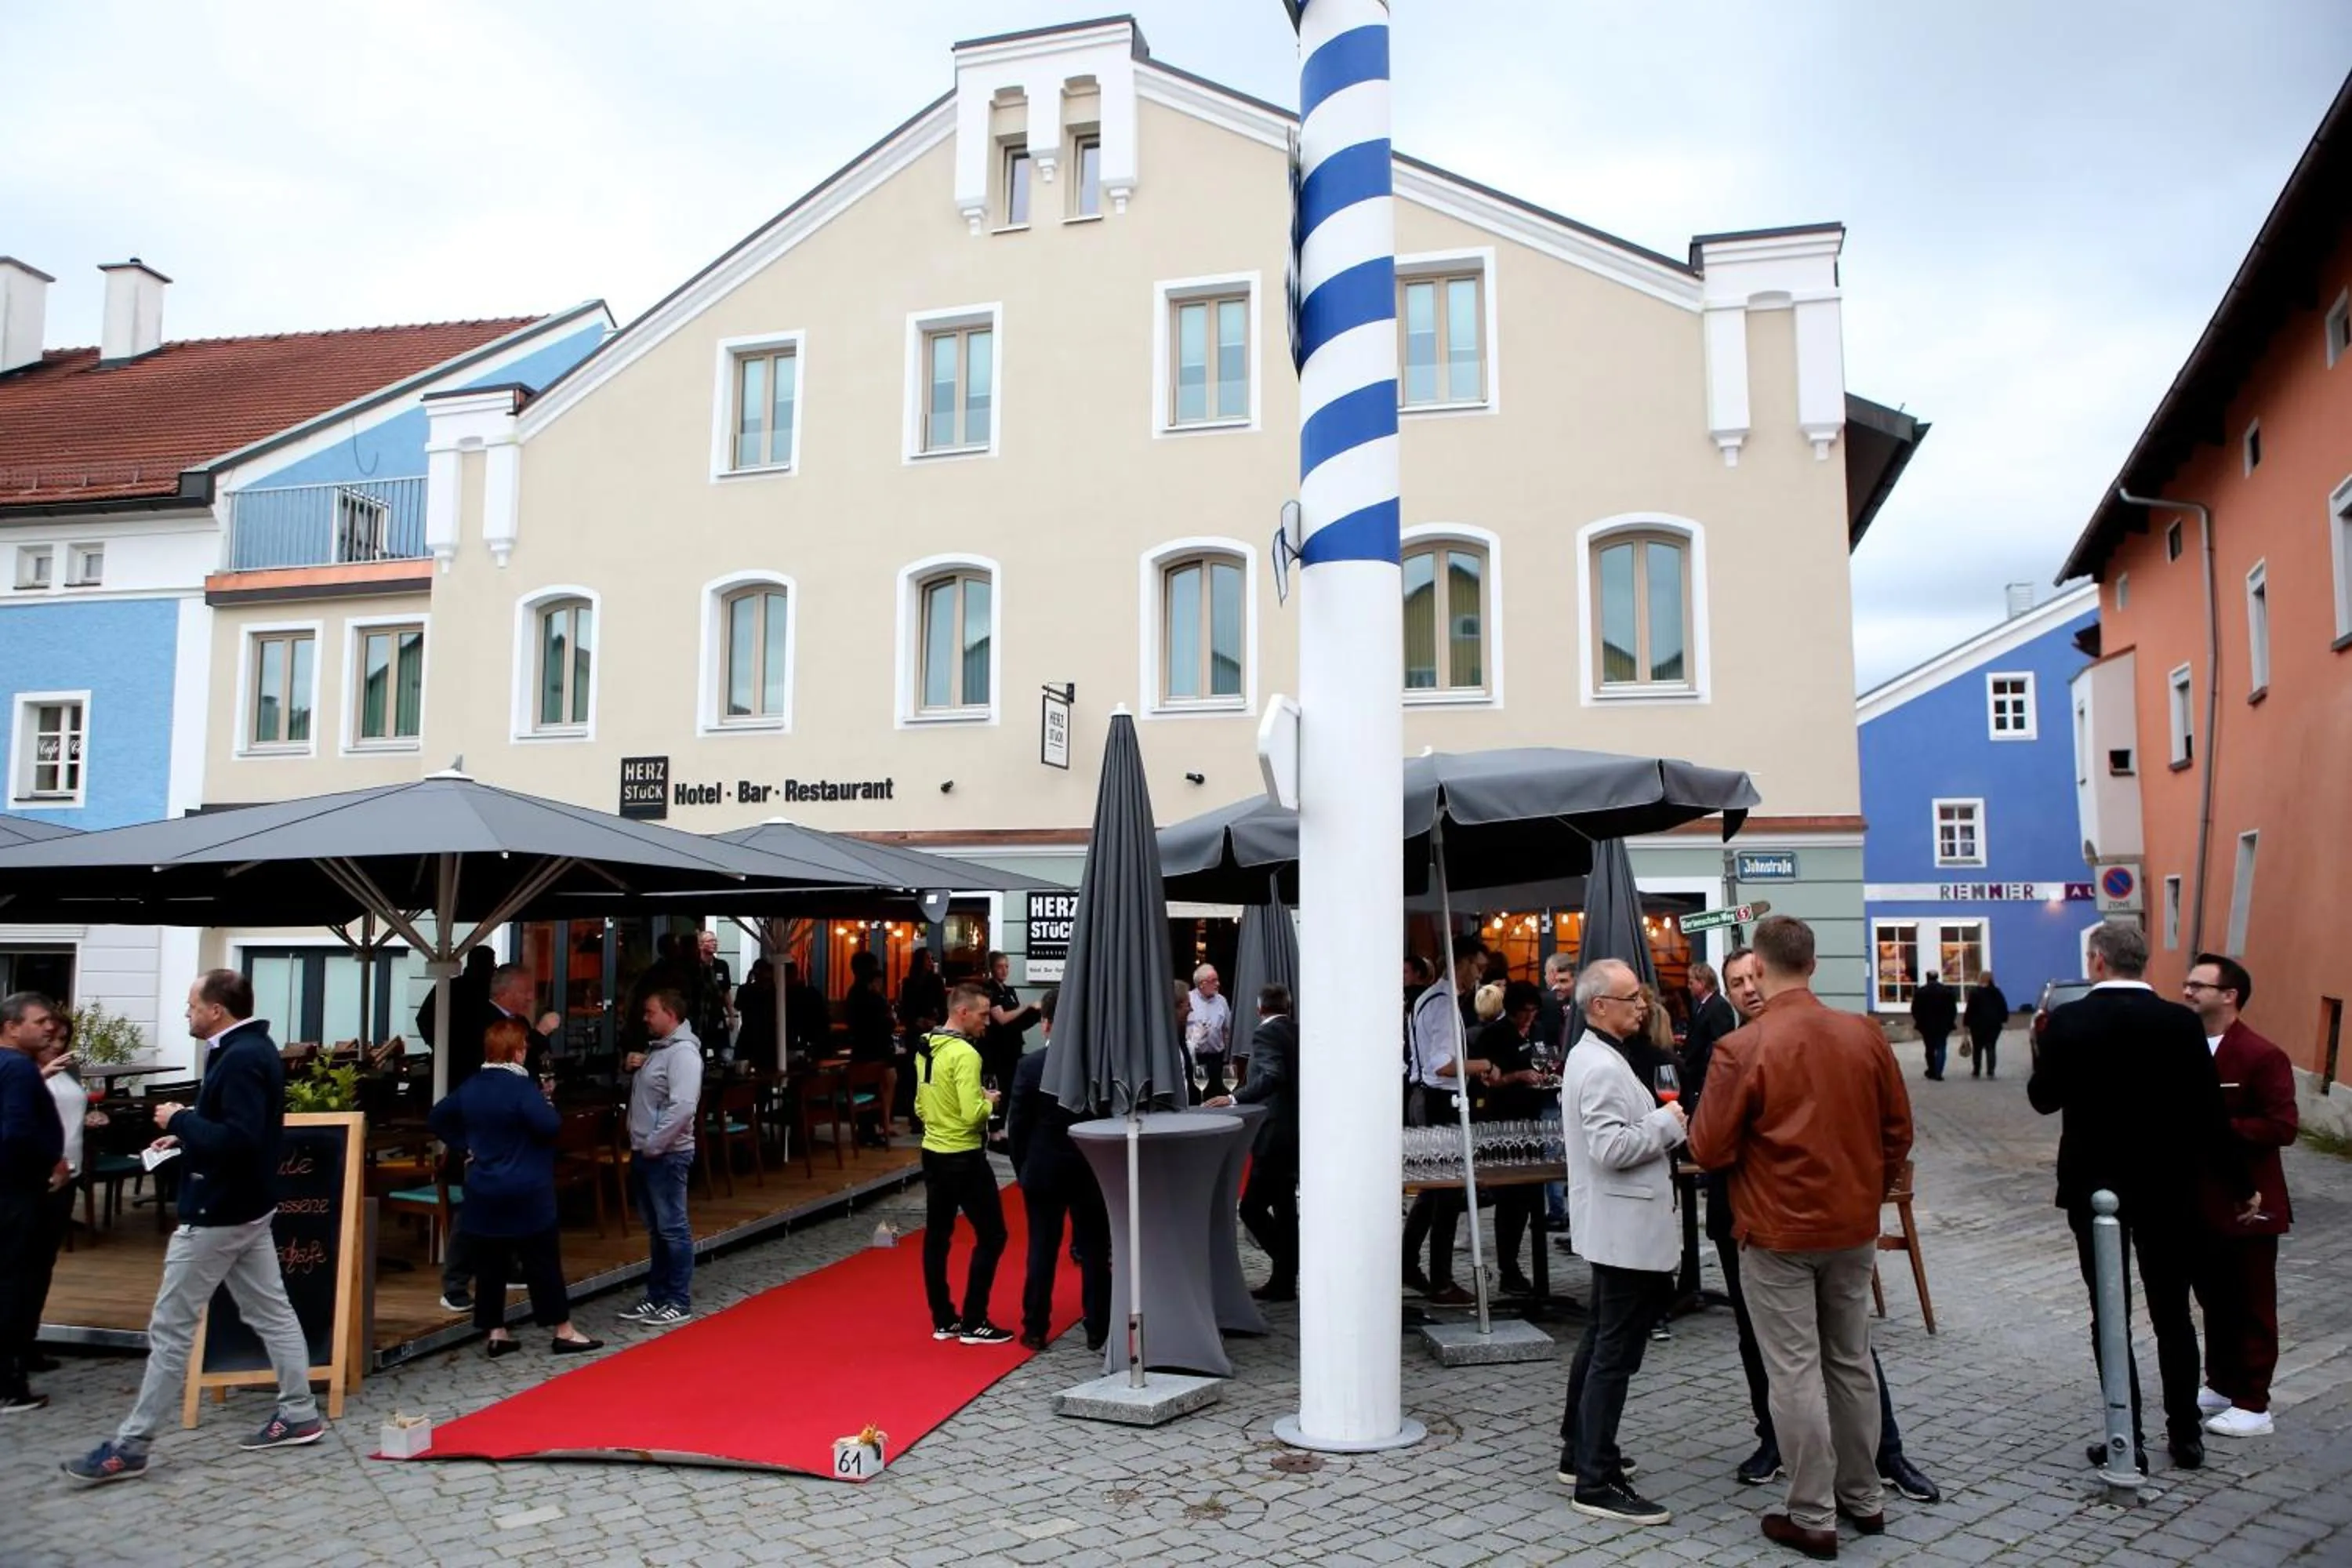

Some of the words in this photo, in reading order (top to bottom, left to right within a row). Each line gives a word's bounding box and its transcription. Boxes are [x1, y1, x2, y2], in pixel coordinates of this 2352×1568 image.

[625, 762, 665, 781] HERZ
[674, 782, 722, 804] Hotel
[738, 780, 771, 803] Bar
[785, 778, 894, 801] Restaurant
[1031, 896, 1080, 917] HERZ
[838, 1449, 862, 1475] 61
